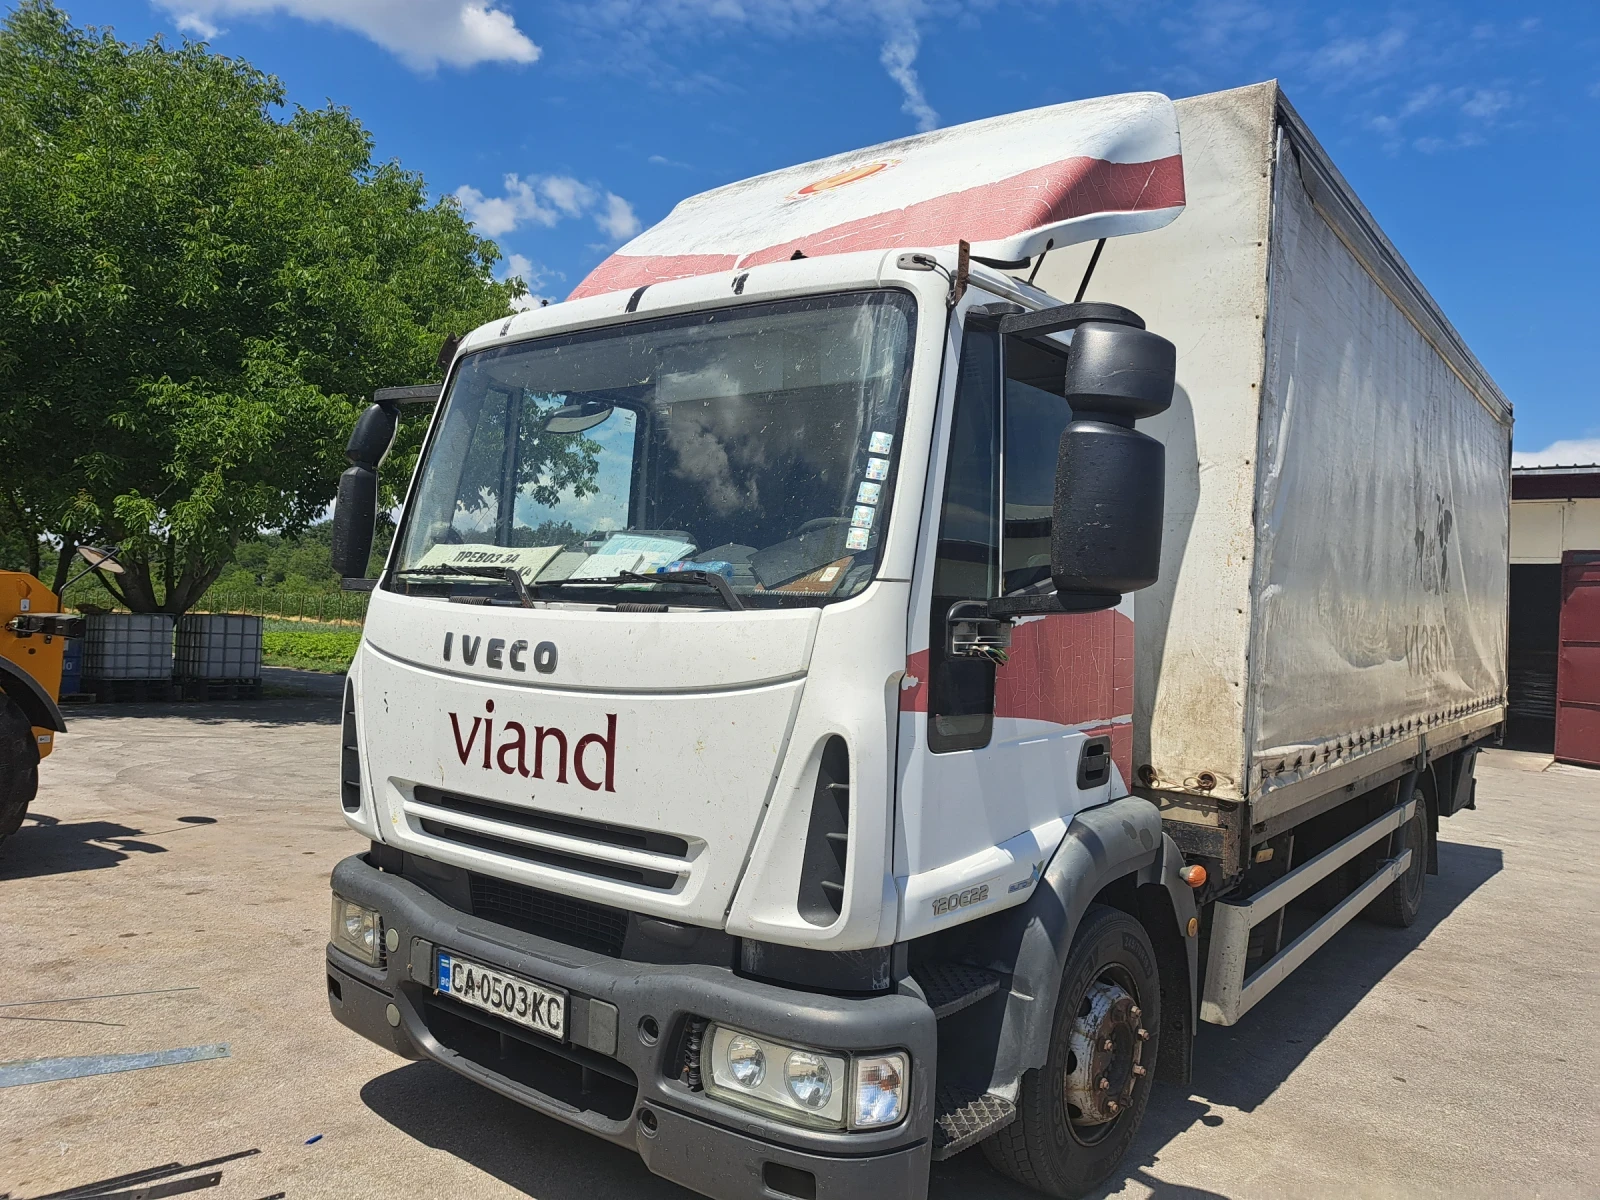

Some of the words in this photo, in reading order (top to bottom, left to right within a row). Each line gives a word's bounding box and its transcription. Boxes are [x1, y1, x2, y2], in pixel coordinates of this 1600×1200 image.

[453, 551, 502, 563] ПРЕВОЗ
[501, 553, 520, 564] ЗА
[443, 632, 559, 674] IVECO
[448, 699, 618, 793] viand
[932, 884, 990, 916] 120E22
[440, 976, 450, 987] BG
